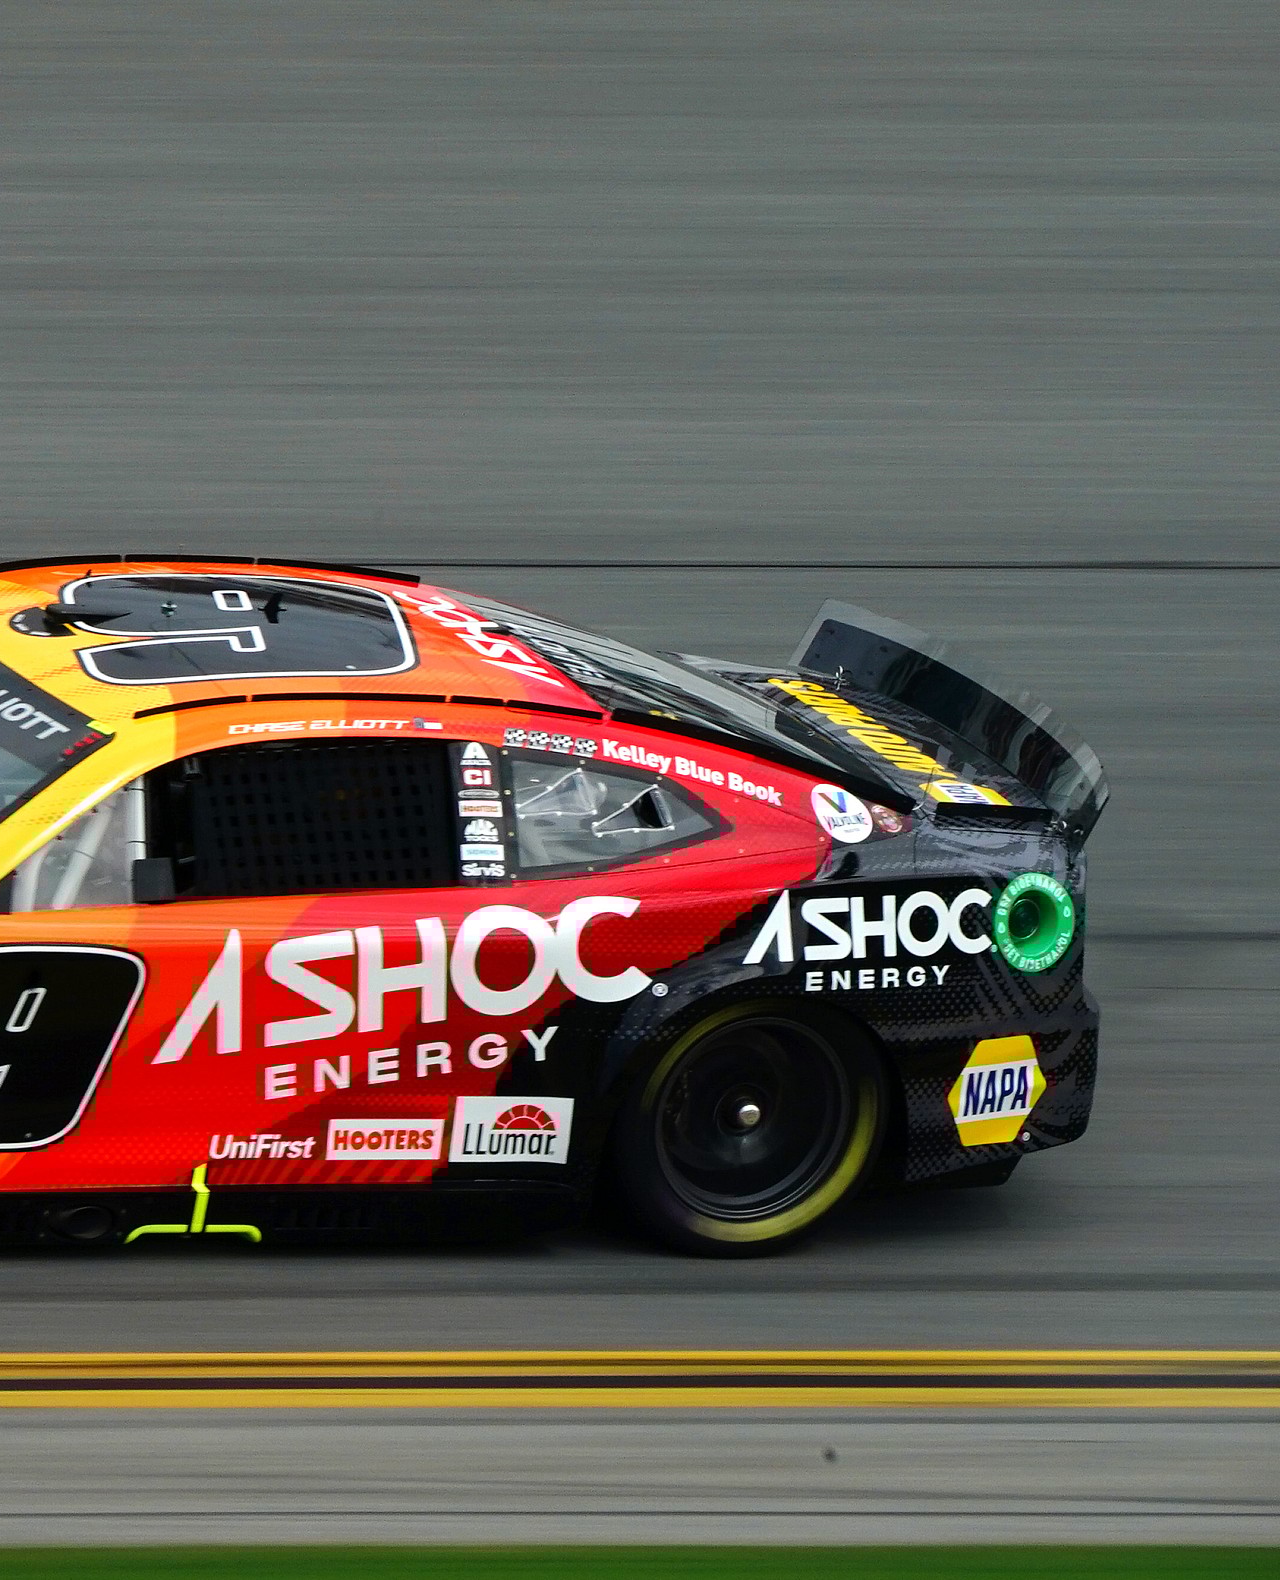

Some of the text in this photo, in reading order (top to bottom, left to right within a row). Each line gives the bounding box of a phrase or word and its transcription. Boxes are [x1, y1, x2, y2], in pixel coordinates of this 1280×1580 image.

[59, 572, 420, 686] 9
[392, 591, 565, 687] ASHOC
[228, 719, 410, 735] CHASE ELLIOTT
[767, 678, 958, 779] AUTO PARTS
[601, 738, 783, 807] Kelley Blue Book
[742, 888, 993, 965] ASHOC
[150, 895, 654, 1065] ASHOC
[805, 964, 951, 992] ENERGY
[264, 1025, 560, 1101] ENERGY
[963, 1065, 1029, 1117] NAPA
[209, 1134, 317, 1160] UniFirst
[333, 1129, 434, 1151] HOOTERS
[462, 1123, 556, 1156] LLumar
